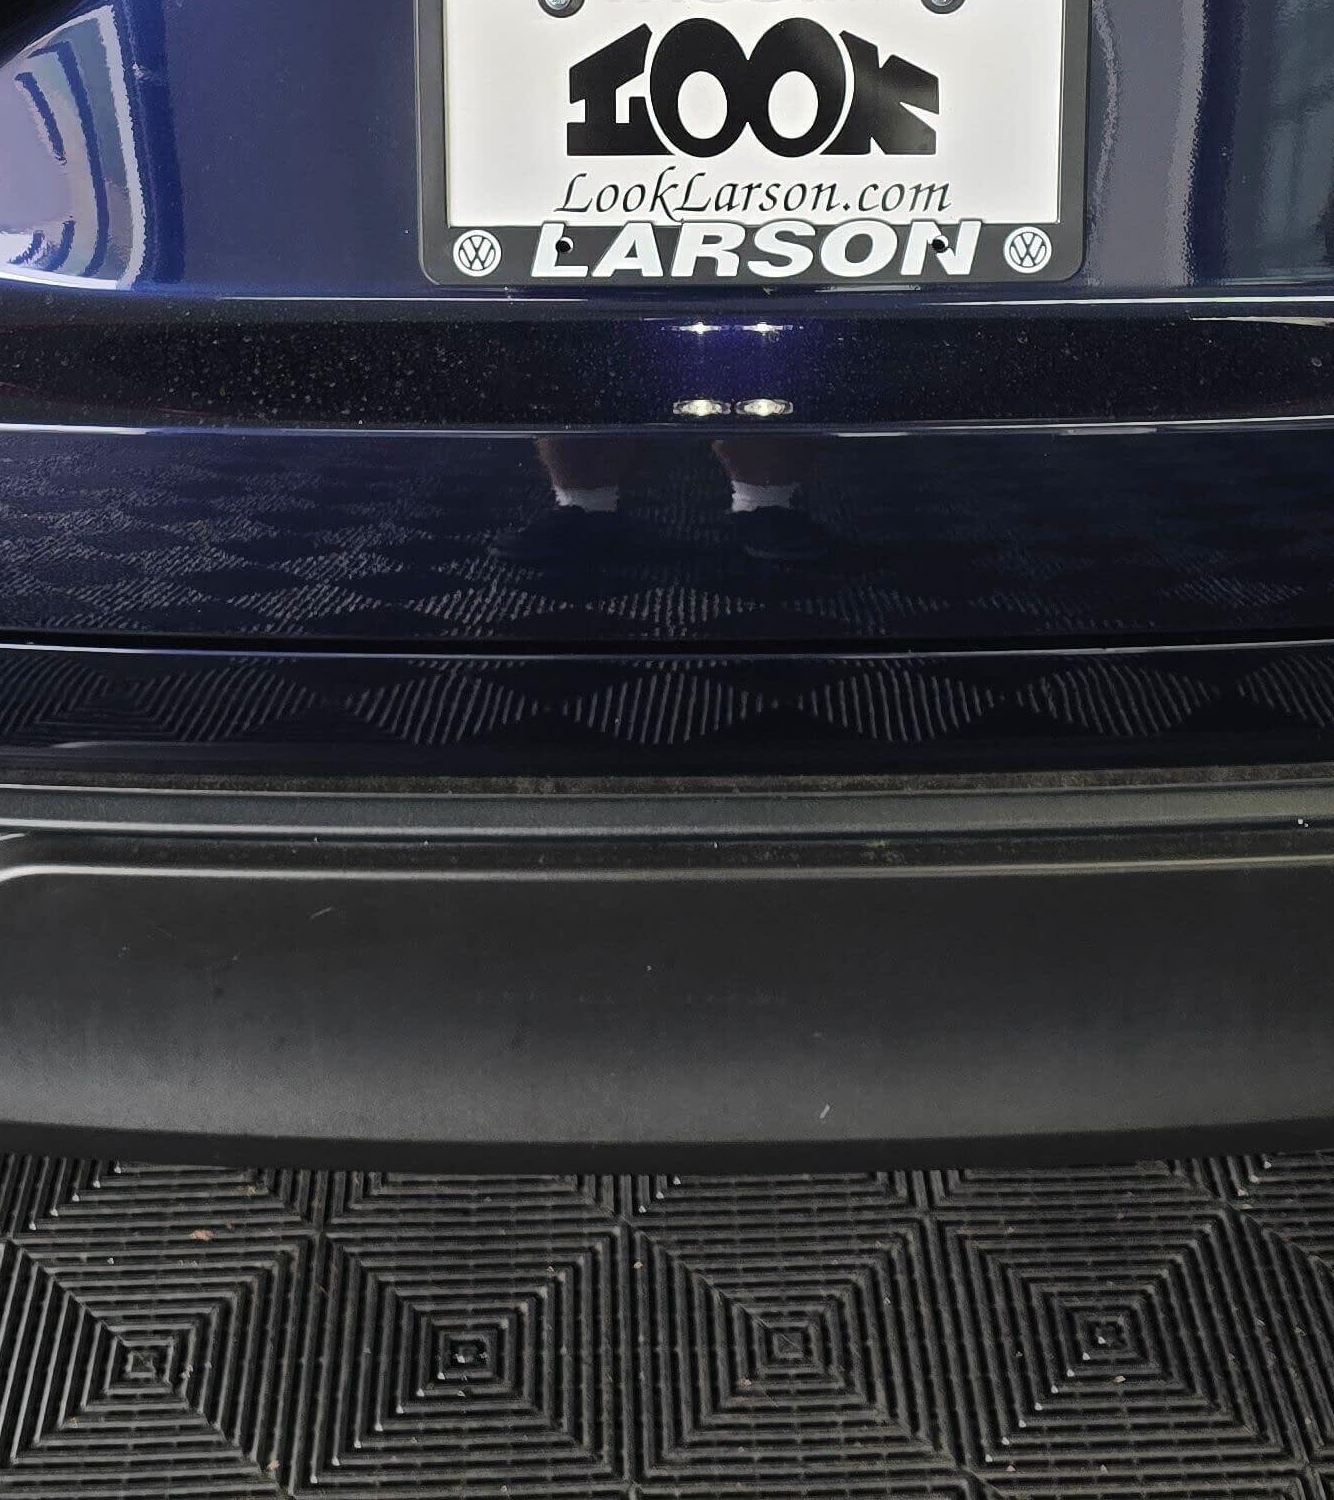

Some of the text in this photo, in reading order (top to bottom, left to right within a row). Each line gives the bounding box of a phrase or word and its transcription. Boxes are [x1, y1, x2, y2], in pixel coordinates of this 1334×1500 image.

[567, 18, 939, 158] LOOK
[554, 166, 953, 222] LookLarson.com
[530, 219, 982, 278] LARSON
